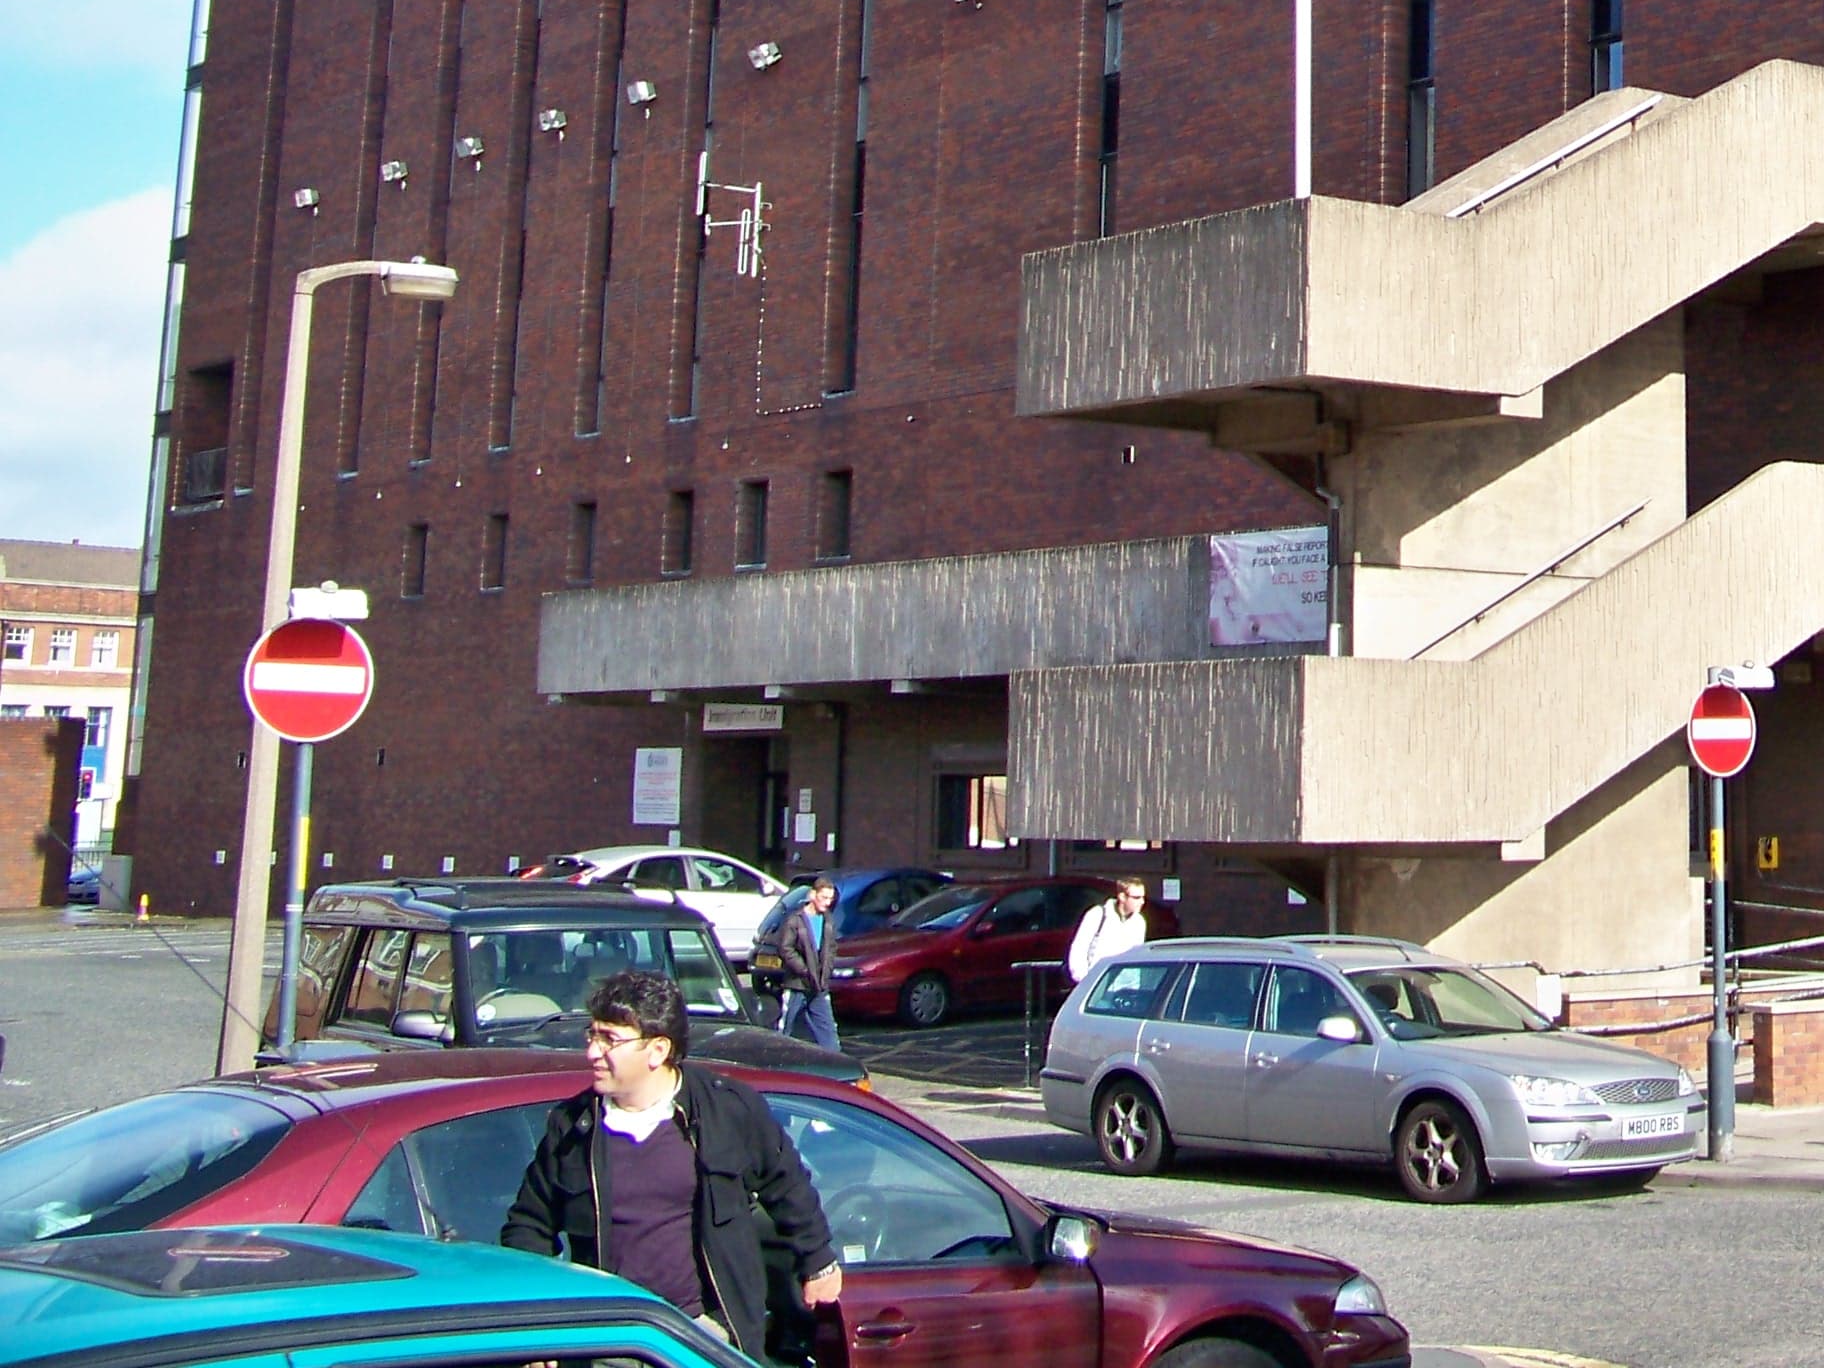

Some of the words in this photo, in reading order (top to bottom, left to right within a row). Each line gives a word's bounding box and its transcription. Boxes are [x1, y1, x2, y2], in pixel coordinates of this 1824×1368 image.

[1283, 543, 1303, 552] FALSE
[1287, 554, 1301, 565] YOU
[1302, 553, 1319, 563] FACE
[1302, 570, 1318, 583] SEE
[1628, 1119, 1657, 1135] M800
[1660, 1116, 1679, 1132] RBS
